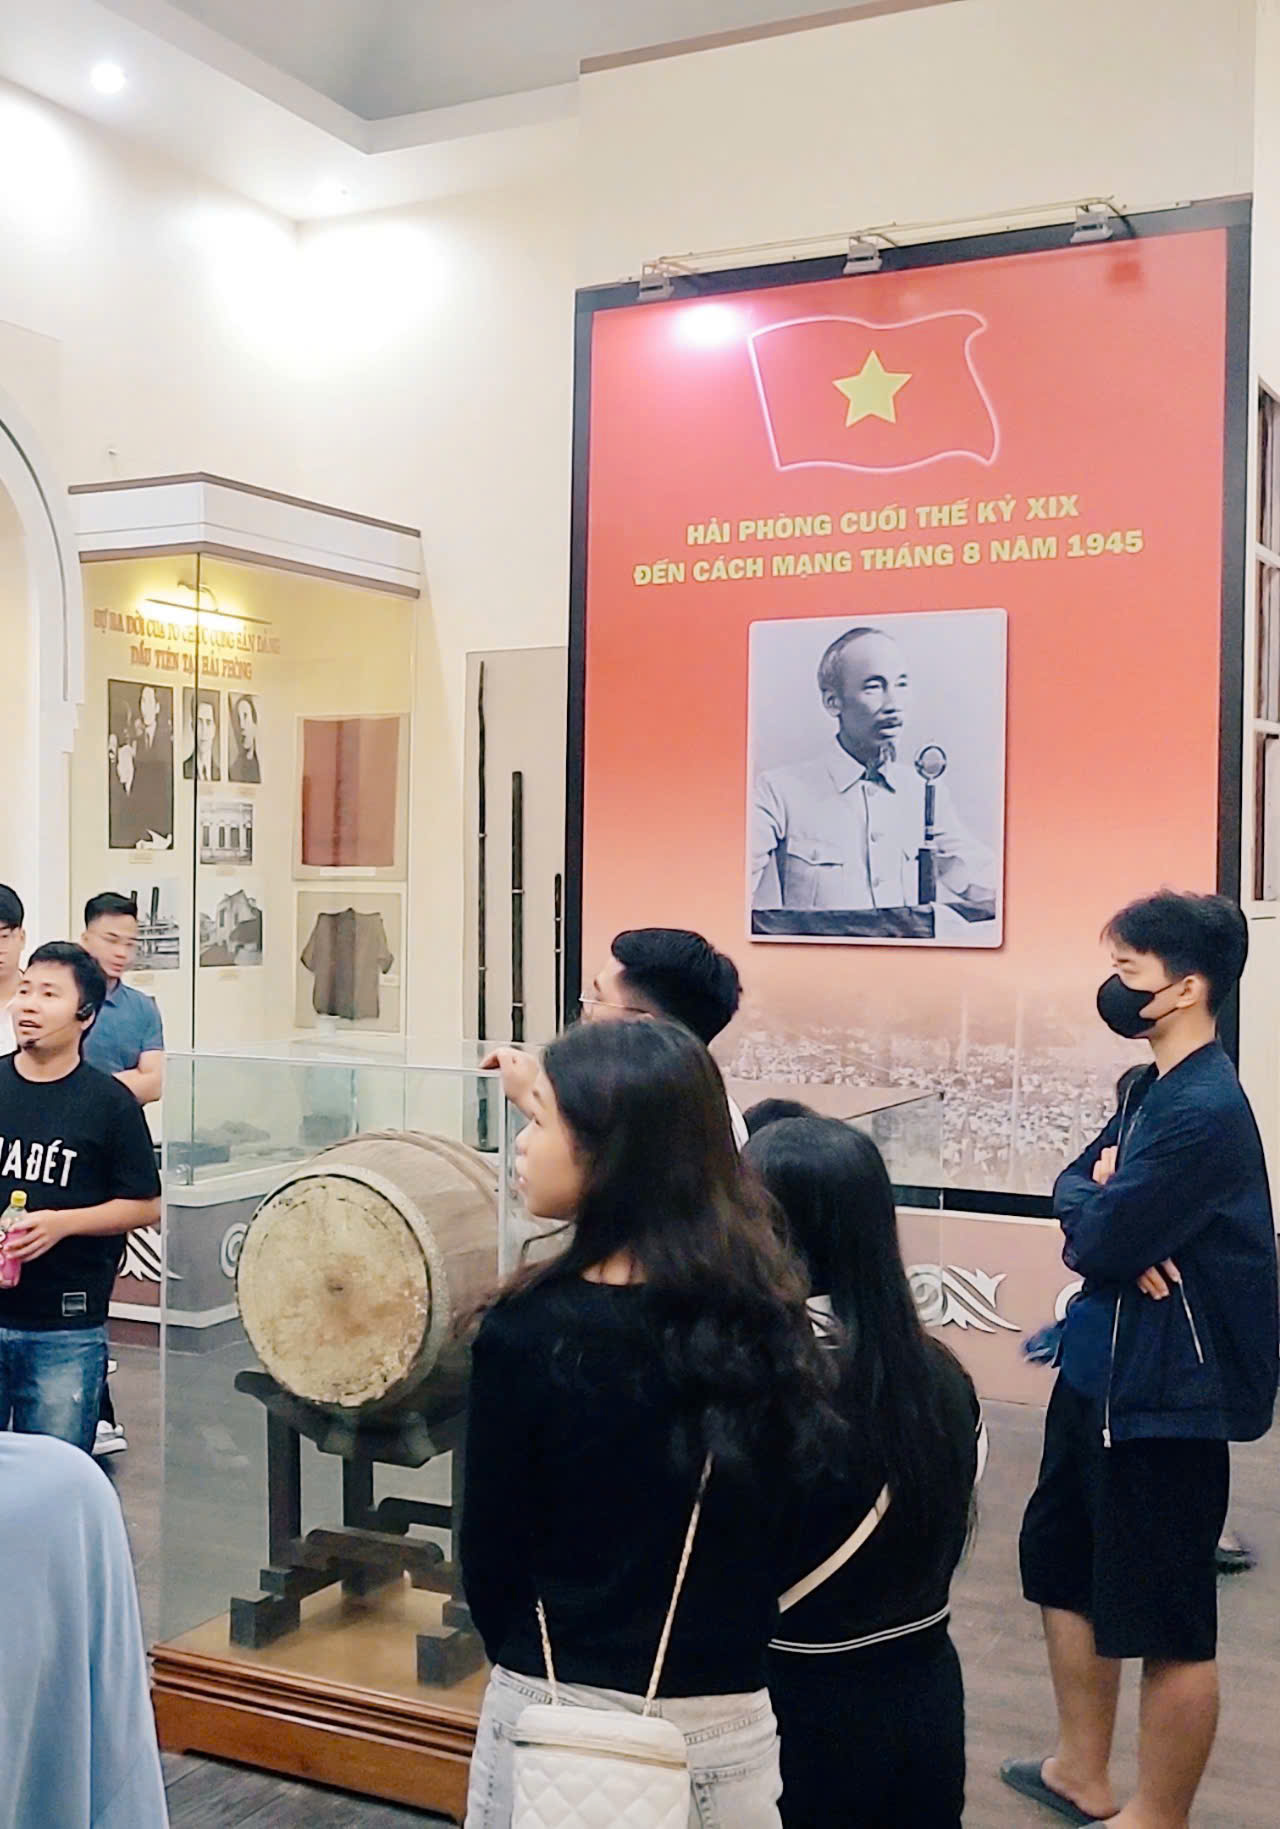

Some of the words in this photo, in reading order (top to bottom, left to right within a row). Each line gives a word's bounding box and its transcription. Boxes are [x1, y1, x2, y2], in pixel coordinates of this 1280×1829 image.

[687, 517, 730, 545] HẢI
[738, 513, 833, 541] PHÒNG
[840, 503, 907, 533] CUỐI
[915, 498, 969, 528] THẾ
[977, 494, 1016, 524] KỶ
[1026, 495, 1079, 520] XIX
[633, 559, 685, 585] ĐẾN
[693, 556, 763, 581] CÁCH
[772, 552, 852, 579] MẠNG
[861, 543, 953, 570] THÁNG
[963, 542, 980, 564] 8
[990, 536, 1057, 562] NĂM
[1067, 530, 1143, 557] 1945
